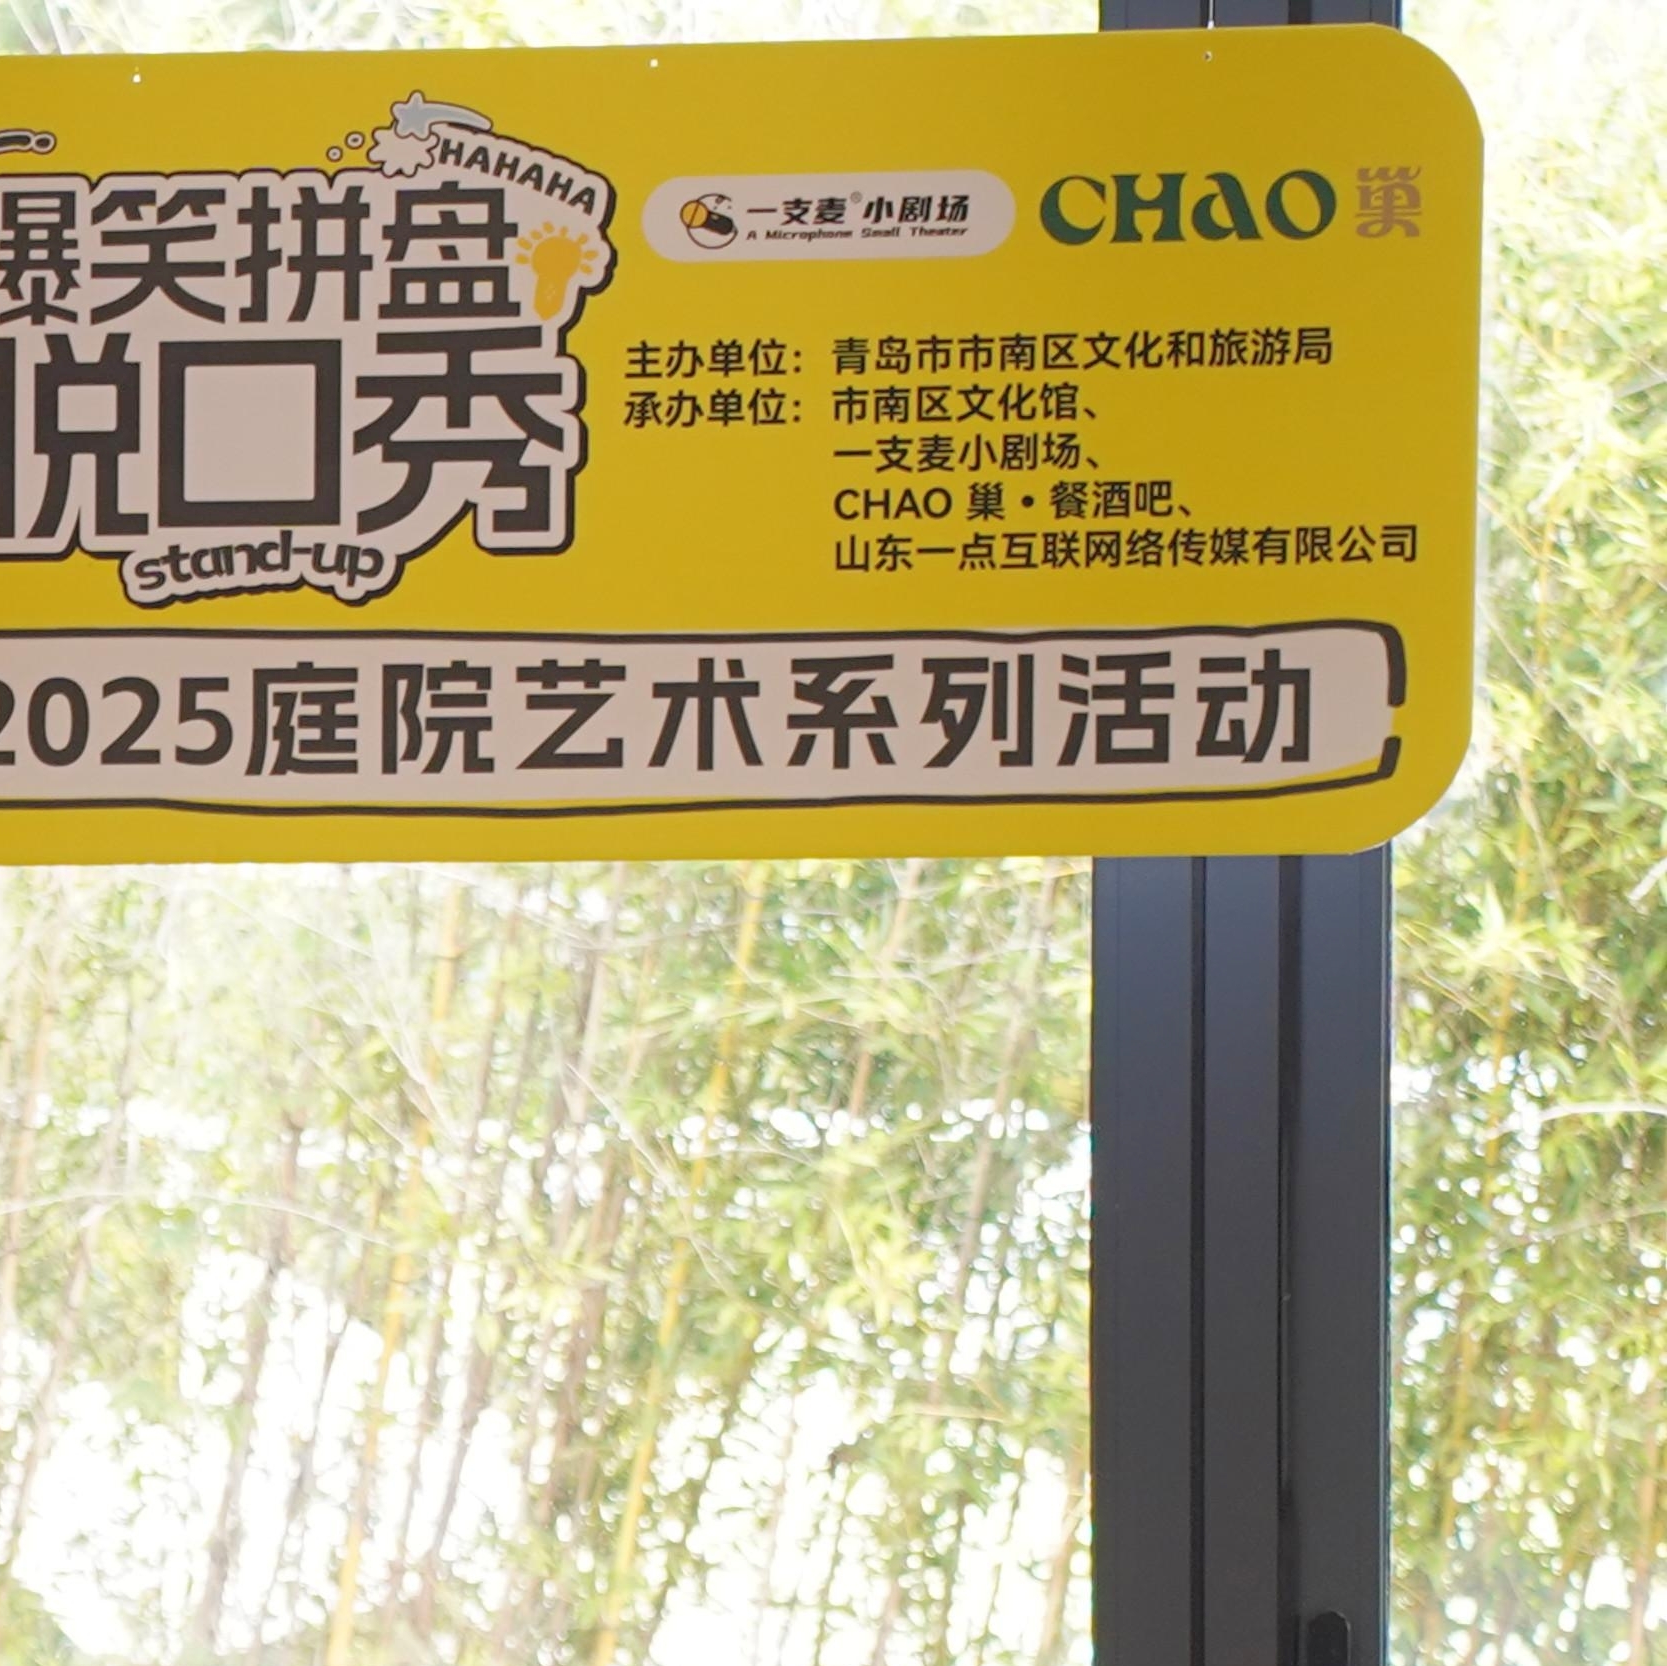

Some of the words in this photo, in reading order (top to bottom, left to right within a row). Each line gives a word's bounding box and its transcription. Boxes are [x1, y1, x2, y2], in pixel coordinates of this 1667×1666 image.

[436, 136, 597, 217] HAHAHA
[766, 229, 853, 242] Microphone
[861, 227, 900, 238] Small
[911, 225, 968, 237] Theater
[624, 338, 803, 379] 主办单位：
[831, 327, 1333, 376] 青岛市市南区文化和旅游局
[623, 387, 803, 429] 承办单位：
[831, 381, 1098, 425] 市南区文化馆、
[832, 431, 1101, 474] 一支麦小剧场、
[833, 486, 953, 520] CHAO
[134, 530, 385, 593] stand-up
[834, 523, 1419, 572] 山东一点互联网络传媒有限公司
